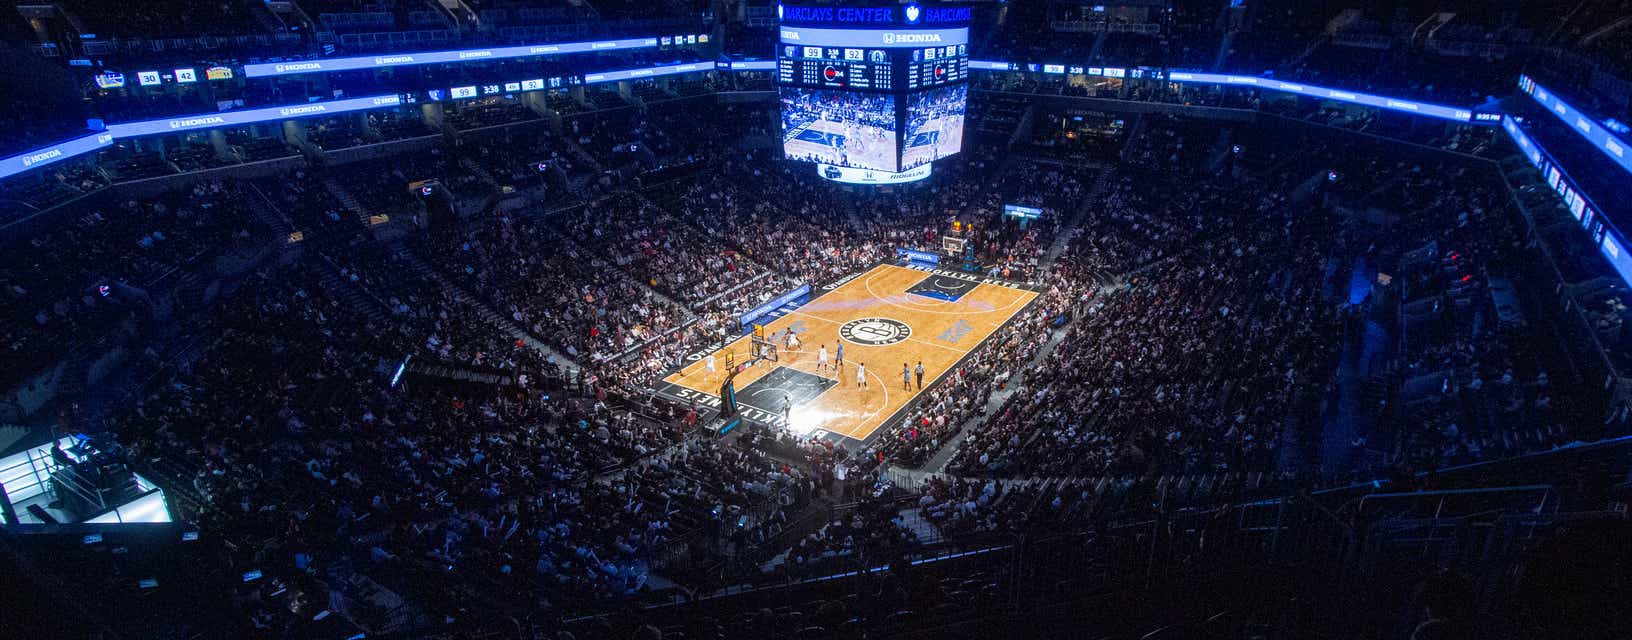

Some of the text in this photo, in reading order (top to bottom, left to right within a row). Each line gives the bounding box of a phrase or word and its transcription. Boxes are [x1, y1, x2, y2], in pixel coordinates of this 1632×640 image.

[785, 7, 894, 21] BARCLAYS CENTER
[896, 33, 942, 42] HONDA
[808, 48, 819, 57] 99
[848, 50, 860, 59] 92
[382, 56, 414, 64] HONDA
[285, 63, 321, 71] HONDA
[143, 75, 156, 83] 30
[180, 72, 192, 80] 42
[459, 89, 470, 97] 99
[483, 85, 499, 94] 3:38
[528, 81, 537, 89] 92
[290, 105, 326, 114] HONDA
[181, 116, 223, 127] HONDA
[31, 149, 61, 163] HONDA
[905, 263, 1020, 290] BROOKLYN NETS
